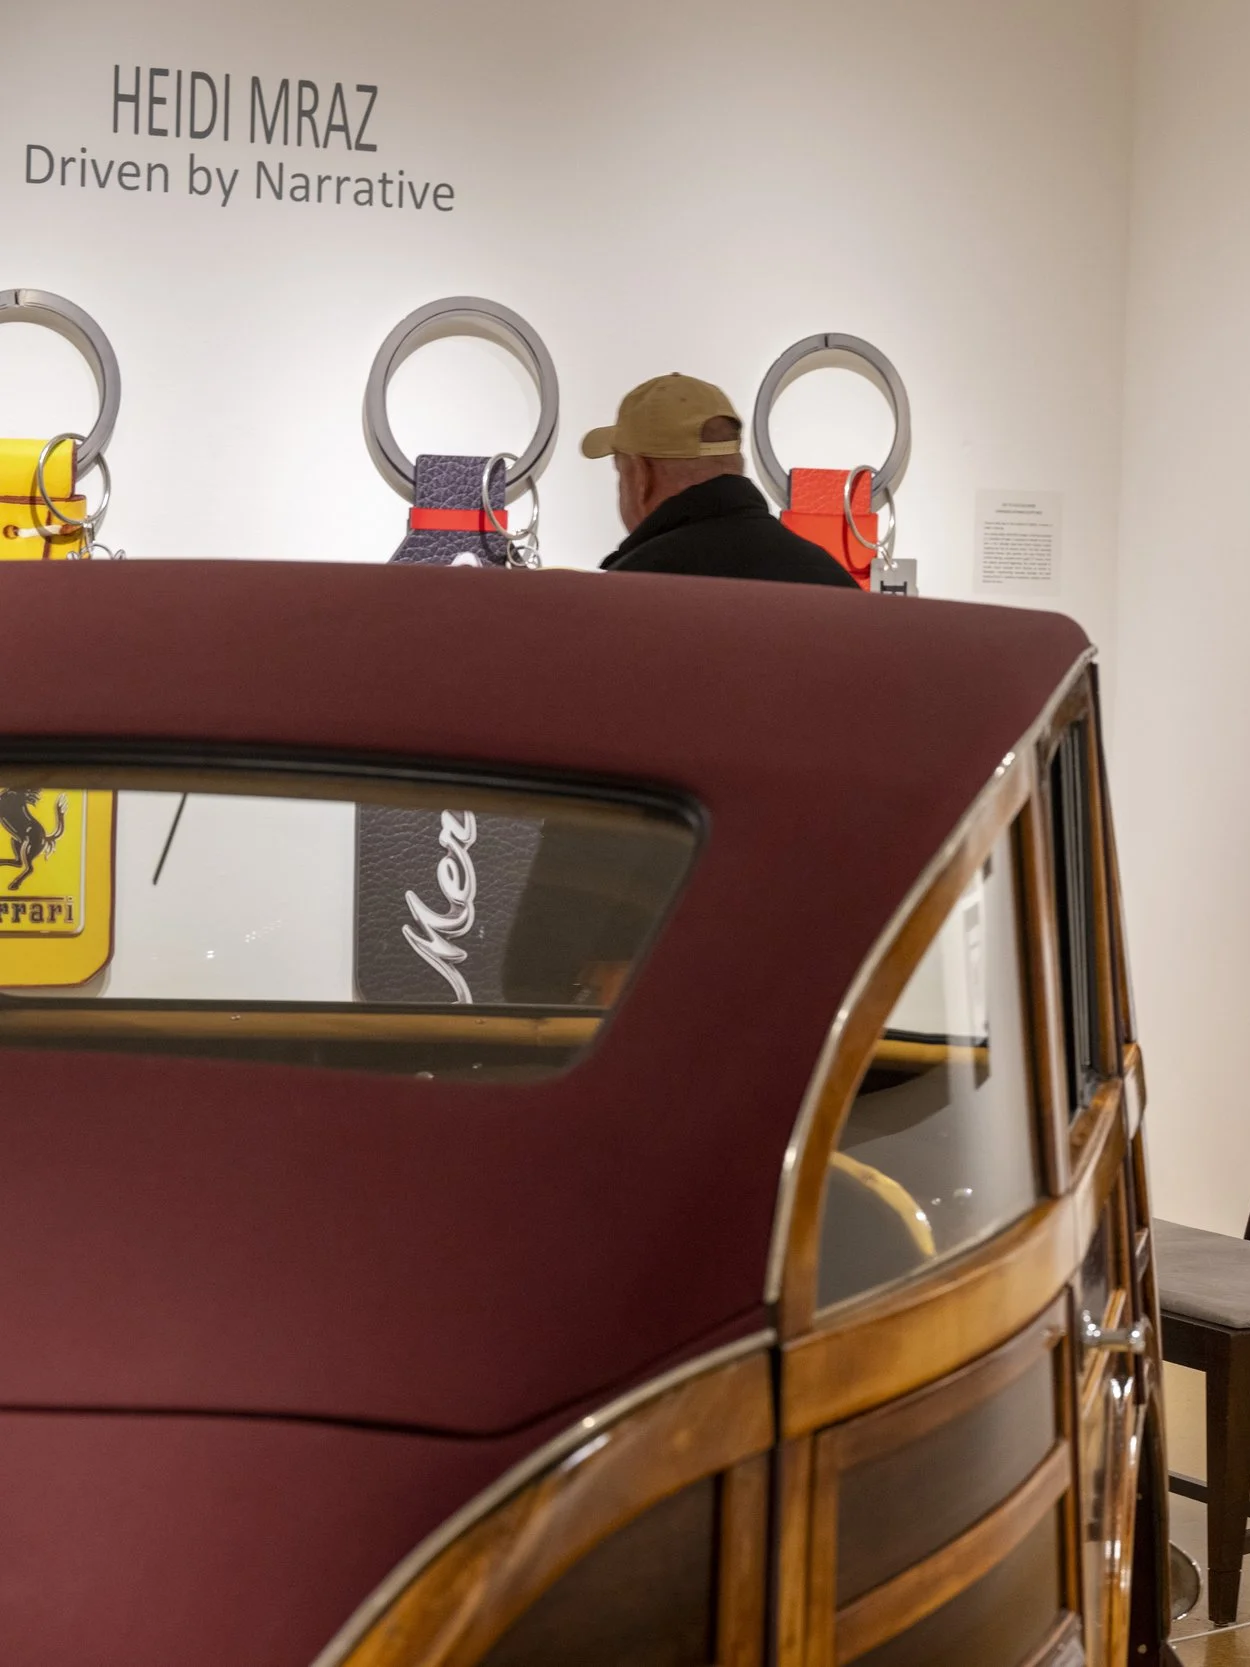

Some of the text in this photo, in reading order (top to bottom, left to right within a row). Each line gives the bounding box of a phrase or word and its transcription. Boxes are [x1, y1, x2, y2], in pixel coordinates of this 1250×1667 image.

[112, 64, 379, 152] HEIDI MRAZ
[25, 143, 456, 212] Driven by Narrative
